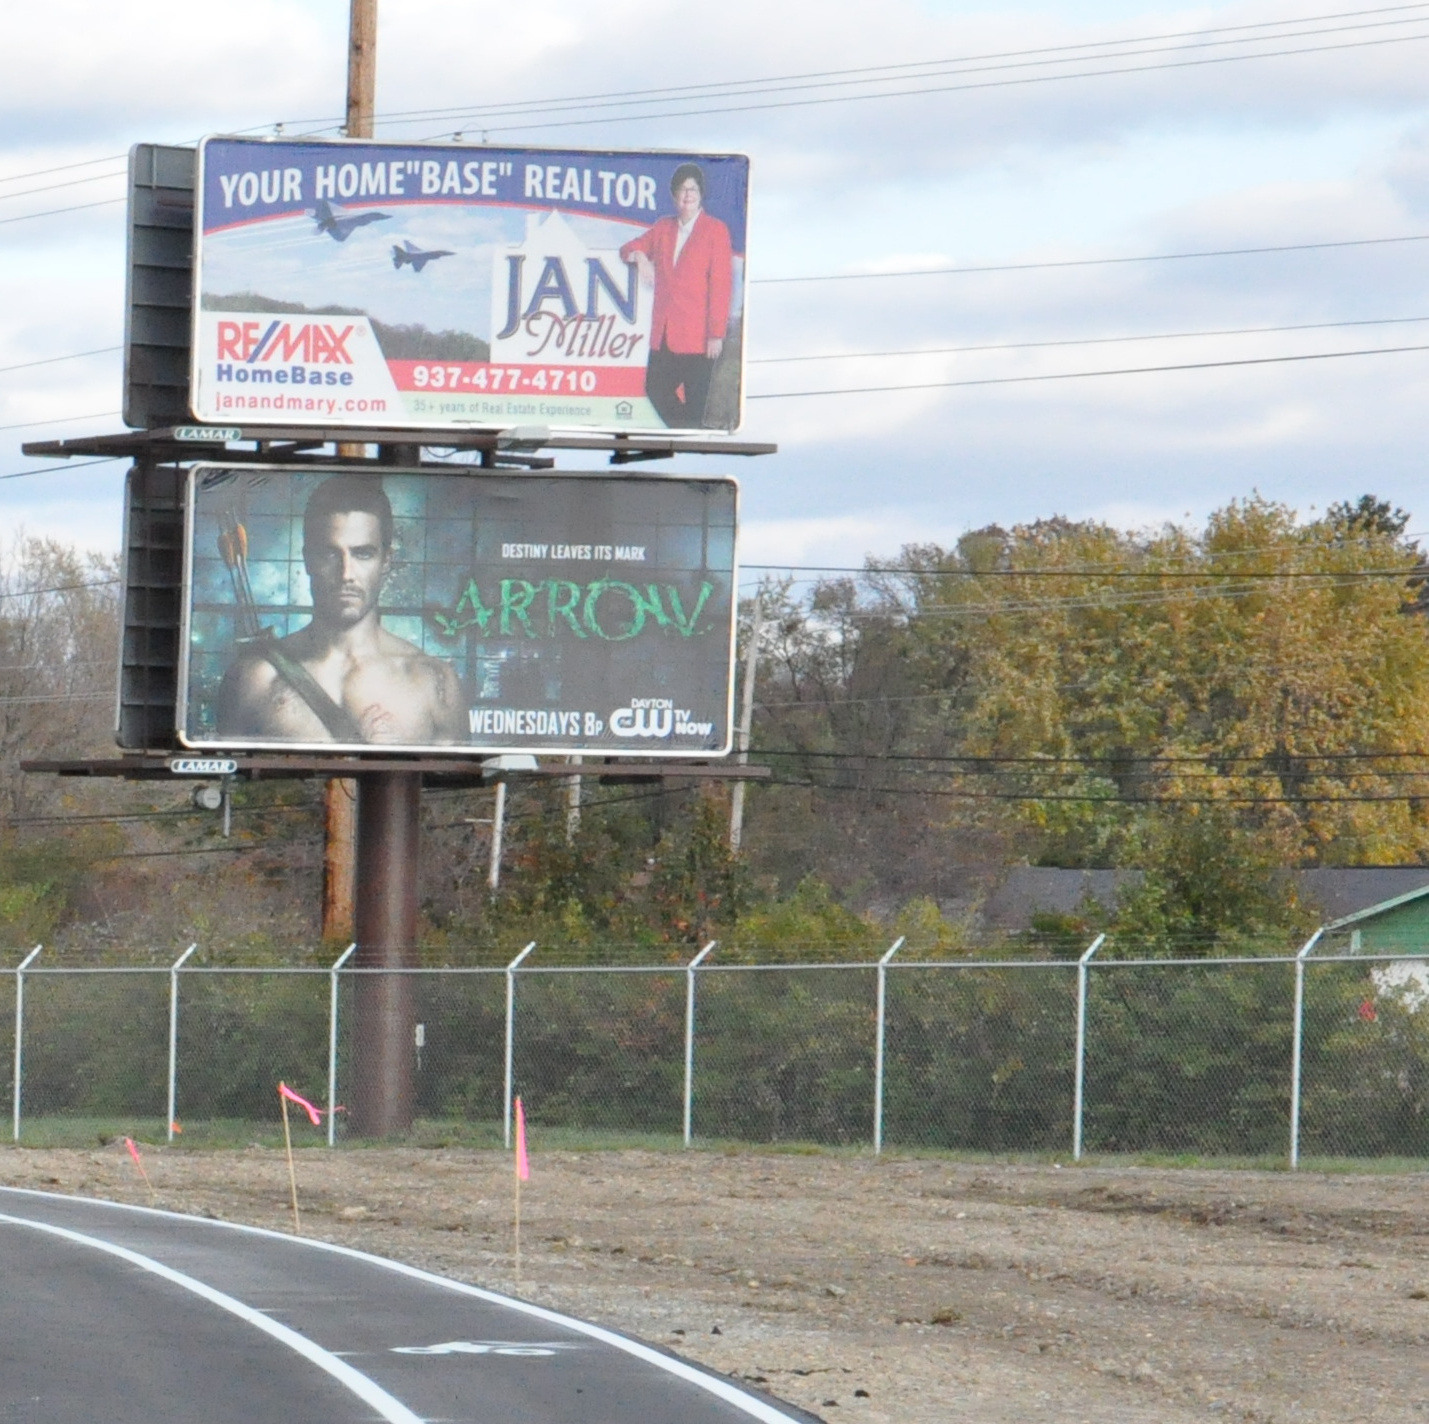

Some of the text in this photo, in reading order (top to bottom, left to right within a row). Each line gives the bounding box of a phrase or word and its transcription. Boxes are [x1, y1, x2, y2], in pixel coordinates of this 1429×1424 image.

[220, 168, 303, 208] YOUR
[524, 164, 657, 210] REALTOR
[496, 254, 639, 340] JAN
[217, 320, 355, 364] RE/MAX
[525, 310, 644, 359] Miller
[216, 363, 355, 386] HomeBase
[413, 365, 597, 392] 937-477-4710
[215, 391, 387, 414] janandmary.com
[440, 402, 466, 413] years
[469, 401, 479, 413] of
[482, 402, 503, 414] Real
[506, 404, 536, 415] Estate
[540, 404, 591, 417] Experience
[179, 428, 235, 440] LAMAR
[502, 543, 646, 560] DESTINY LEAVES ITS MARK
[434, 575, 714, 641] ARROW
[631, 698, 672, 709] DAYTON
[468, 708, 580, 736] WEDNESDAYS
[674, 709, 691, 722] TV
[675, 722, 713, 735] NOW
[178, 761, 232, 773] LAMAR
